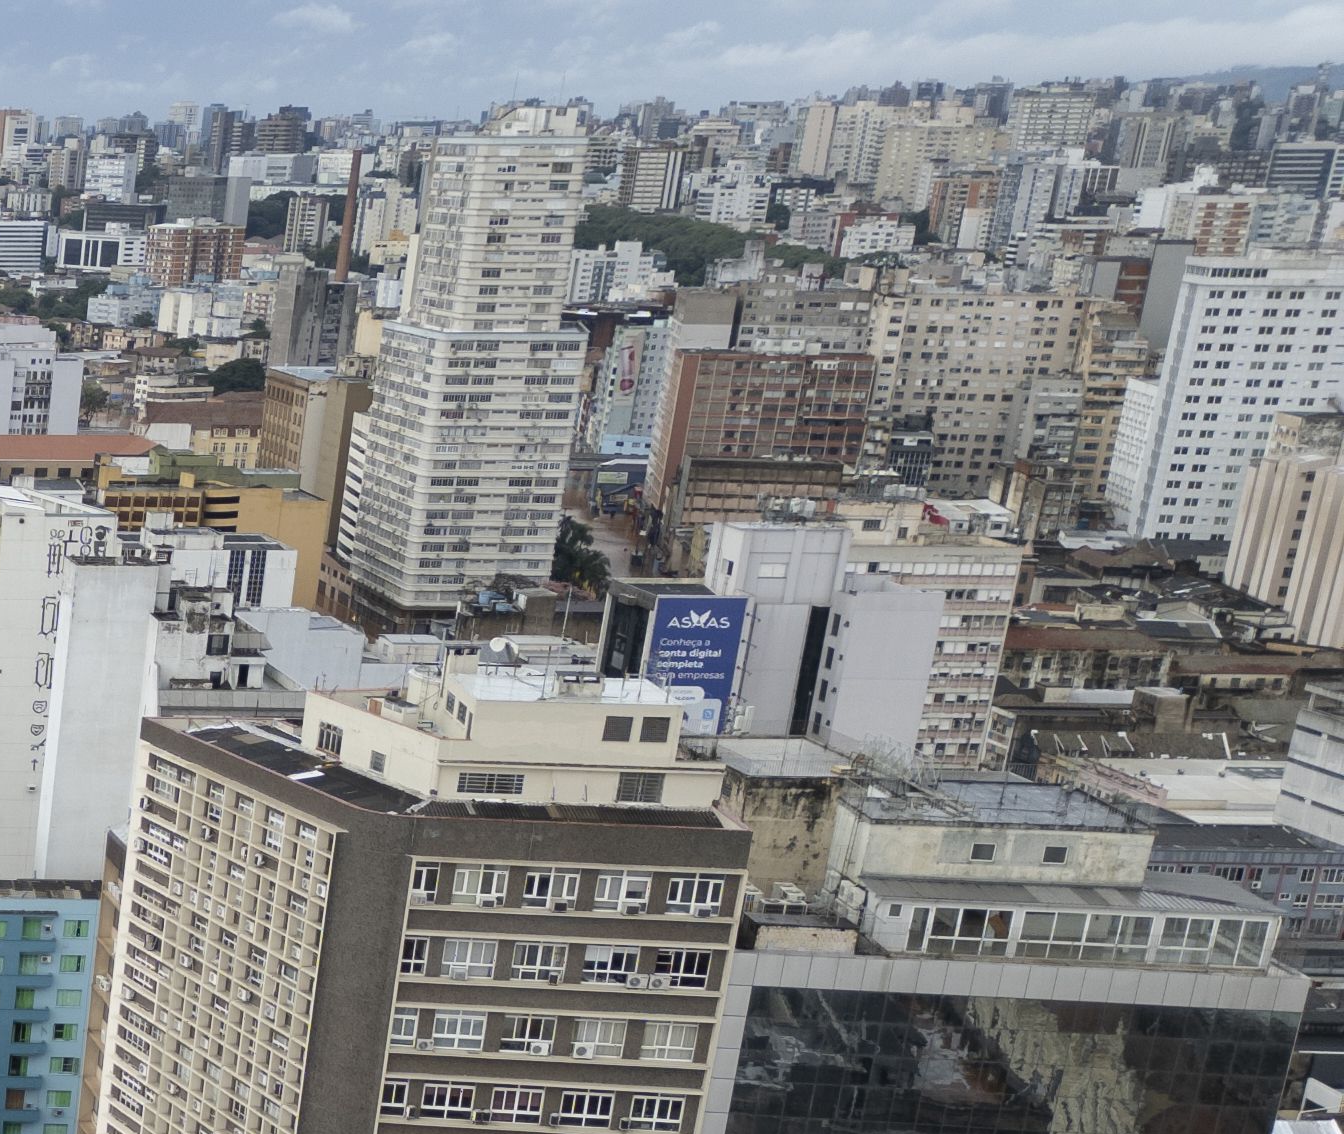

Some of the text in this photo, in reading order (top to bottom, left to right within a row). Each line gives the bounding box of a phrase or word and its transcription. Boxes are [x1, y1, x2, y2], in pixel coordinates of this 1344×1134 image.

[667, 610, 730, 628] ASAAS
[660, 638, 703, 648] Conheça
[658, 648, 722, 658] conta digital
[656, 660, 704, 669] completa
[678, 672, 725, 681] empresas
